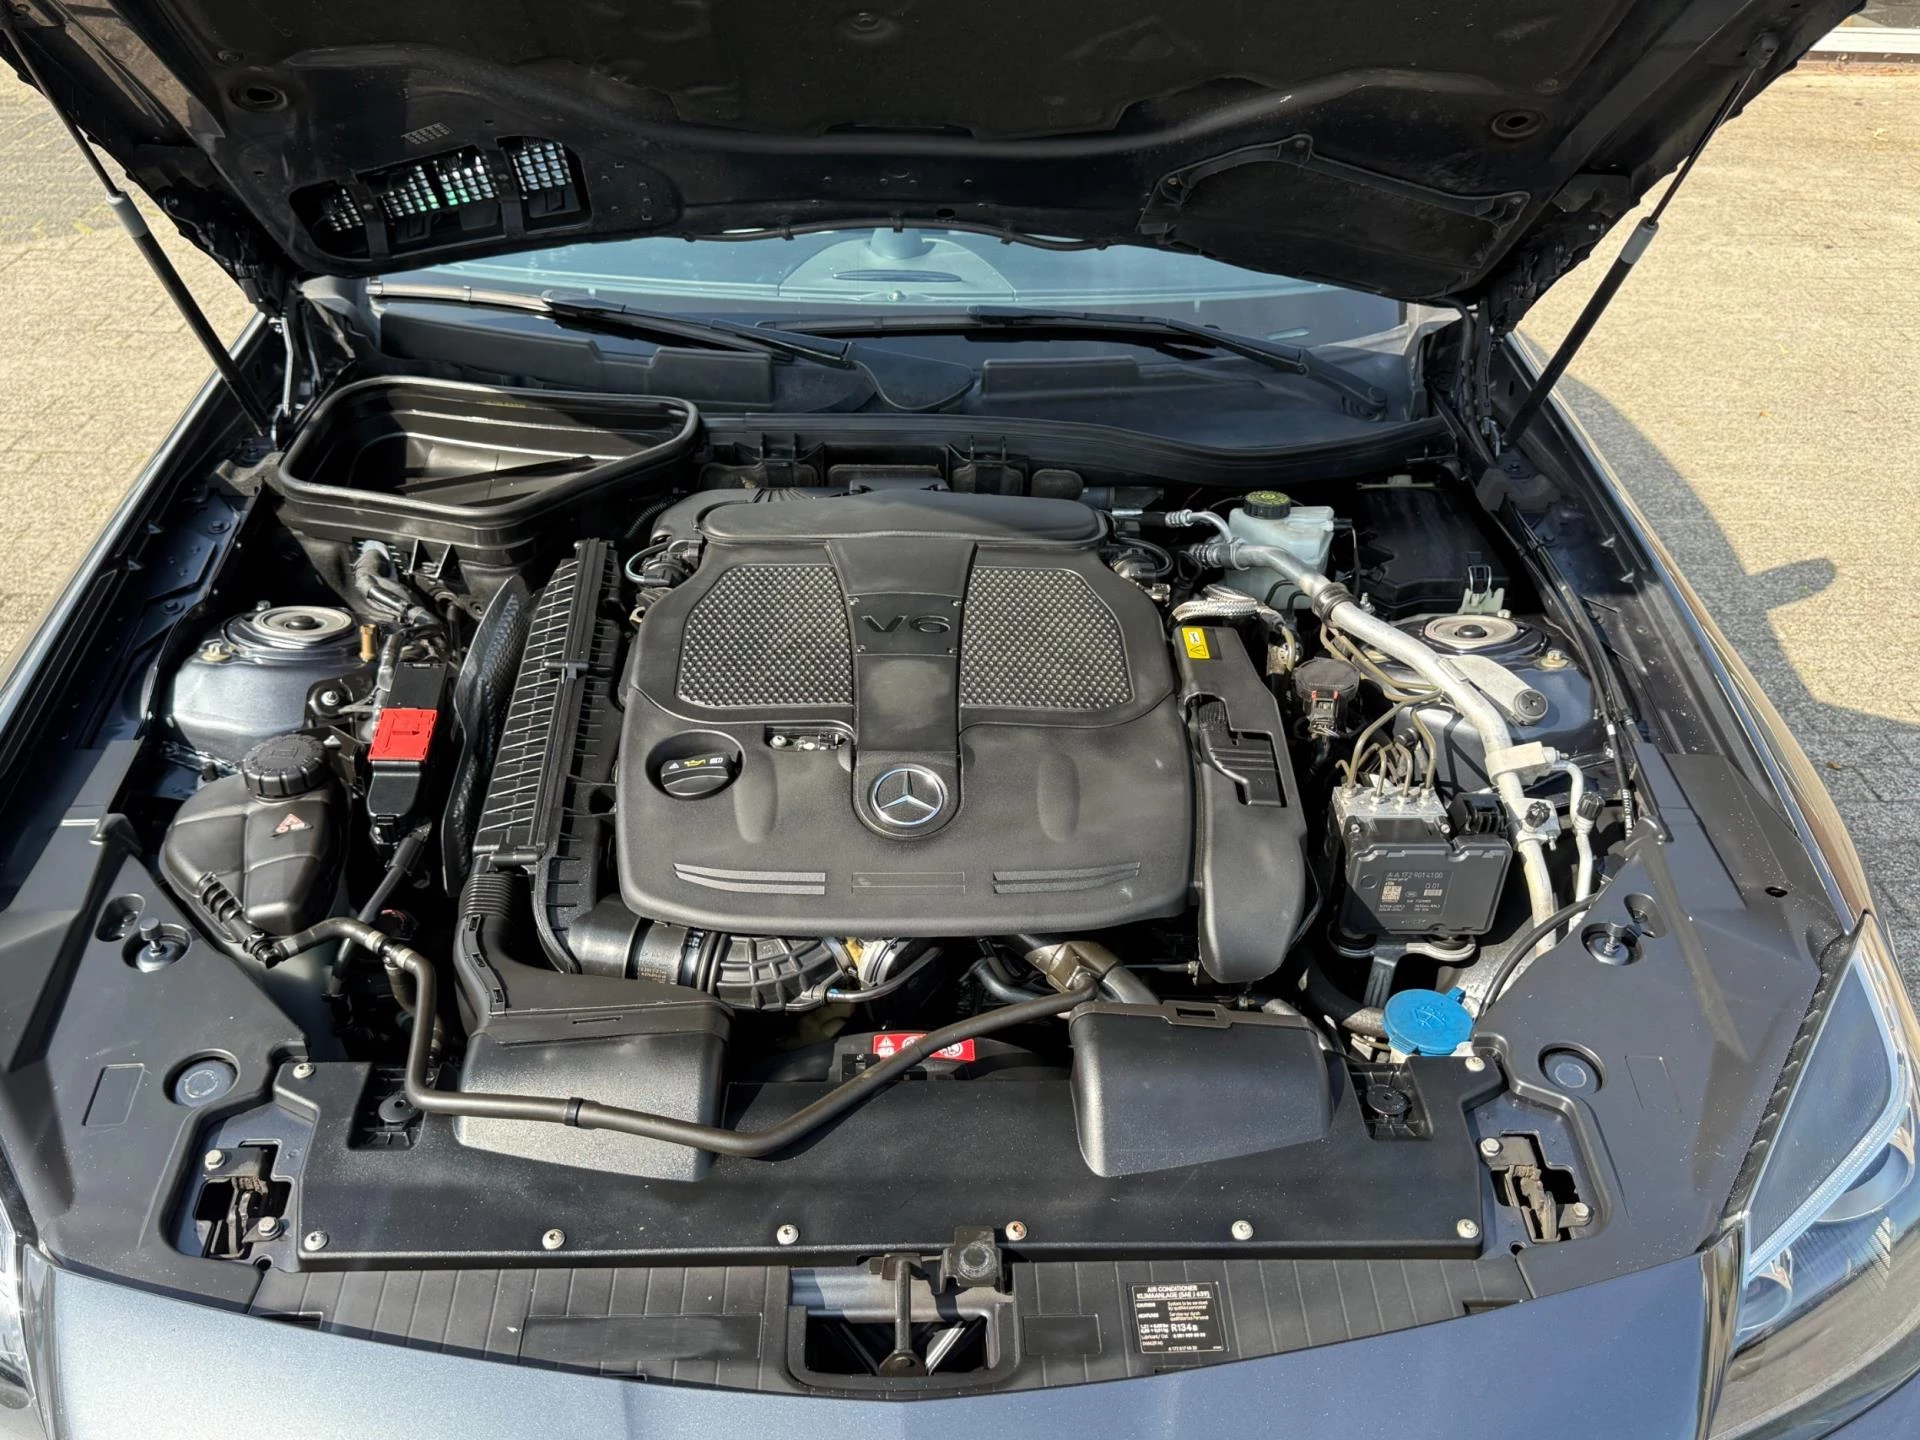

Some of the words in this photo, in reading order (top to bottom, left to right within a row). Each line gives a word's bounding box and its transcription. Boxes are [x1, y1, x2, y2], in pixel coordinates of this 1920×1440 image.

[861, 615, 951, 633] V6
[1136, 1291, 1178, 1299] KLIMAANLAGE
[1170, 1323, 1199, 1333] R134a
